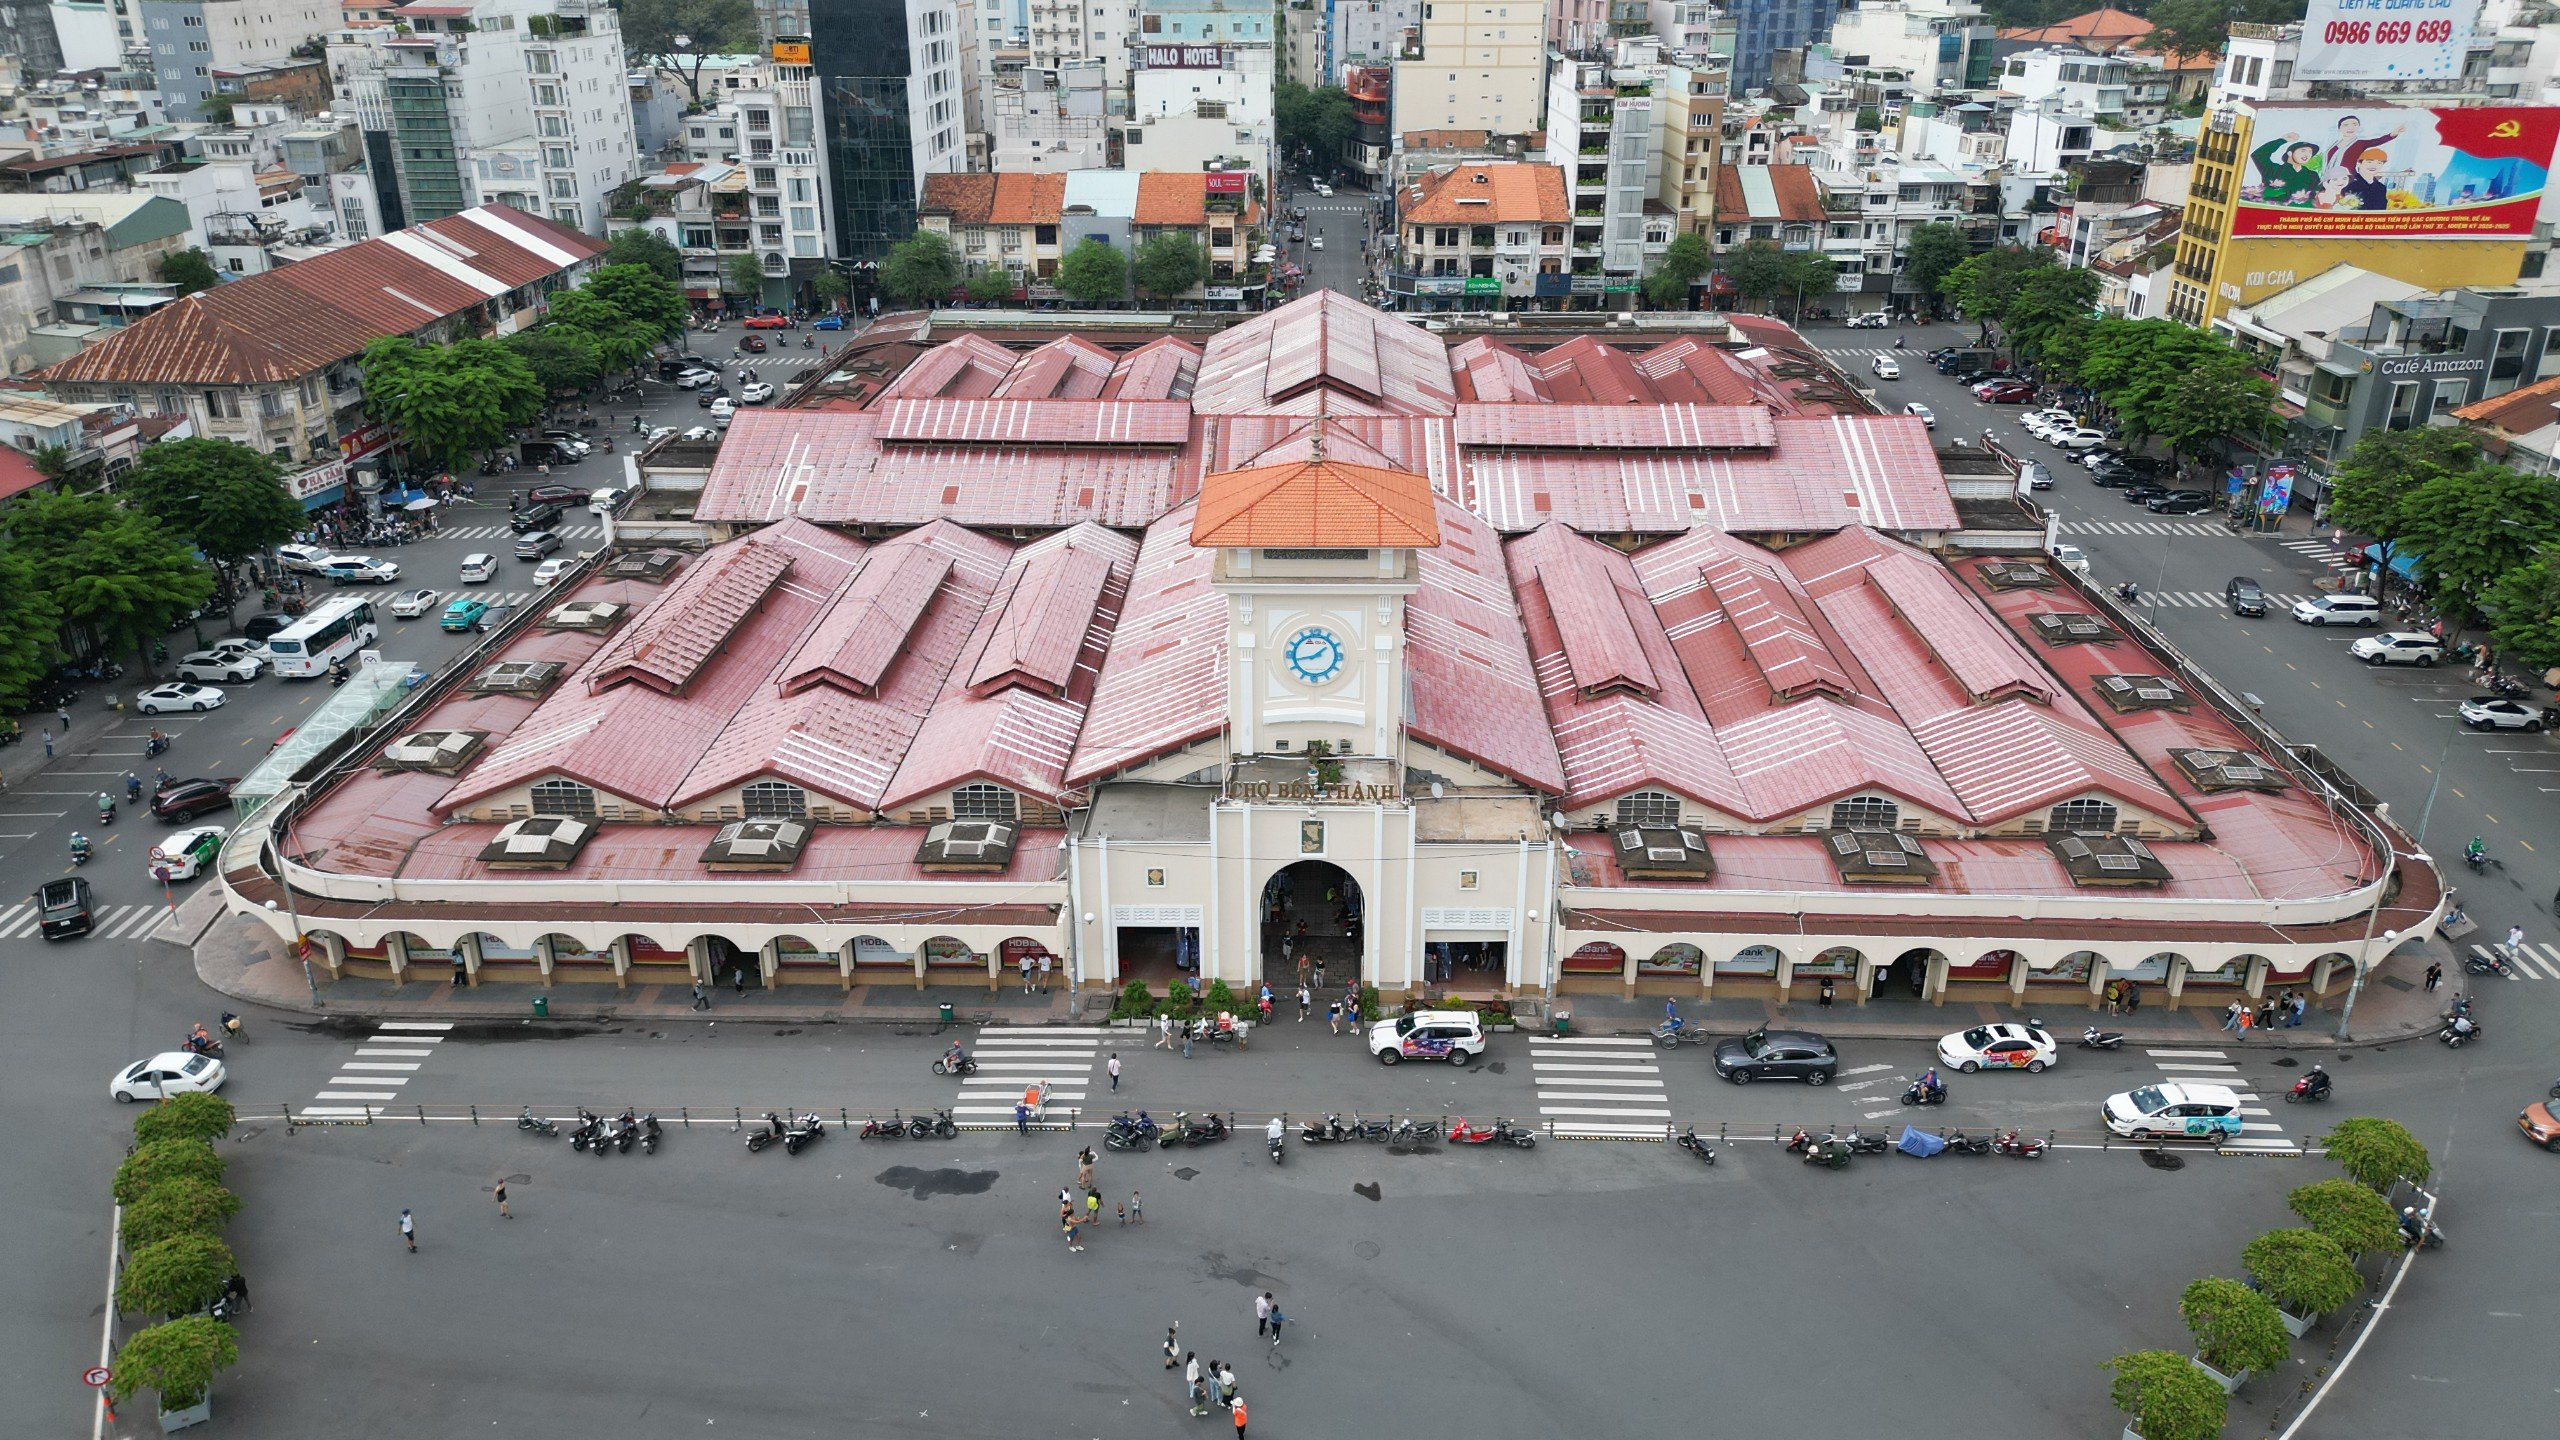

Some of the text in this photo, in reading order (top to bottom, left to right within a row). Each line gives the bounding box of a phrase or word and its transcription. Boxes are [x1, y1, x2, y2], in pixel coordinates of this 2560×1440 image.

[2324, 19, 2451, 44] 0986 669 689
[1148, 48, 1220, 65] HALO HOTEL
[2267, 270, 2294, 285] CHA
[2381, 357, 2484, 375] Café Amazon
[2297, 464, 2308, 476] afé
[1231, 780, 1271, 799] CHỢ
[635, 936, 656, 944] HDB
[861, 938, 890, 946] HDBa
[1009, 939, 1044, 947] HDBan
[1577, 945, 1608, 953] DBank
[1979, 953, 1996, 961] ank
